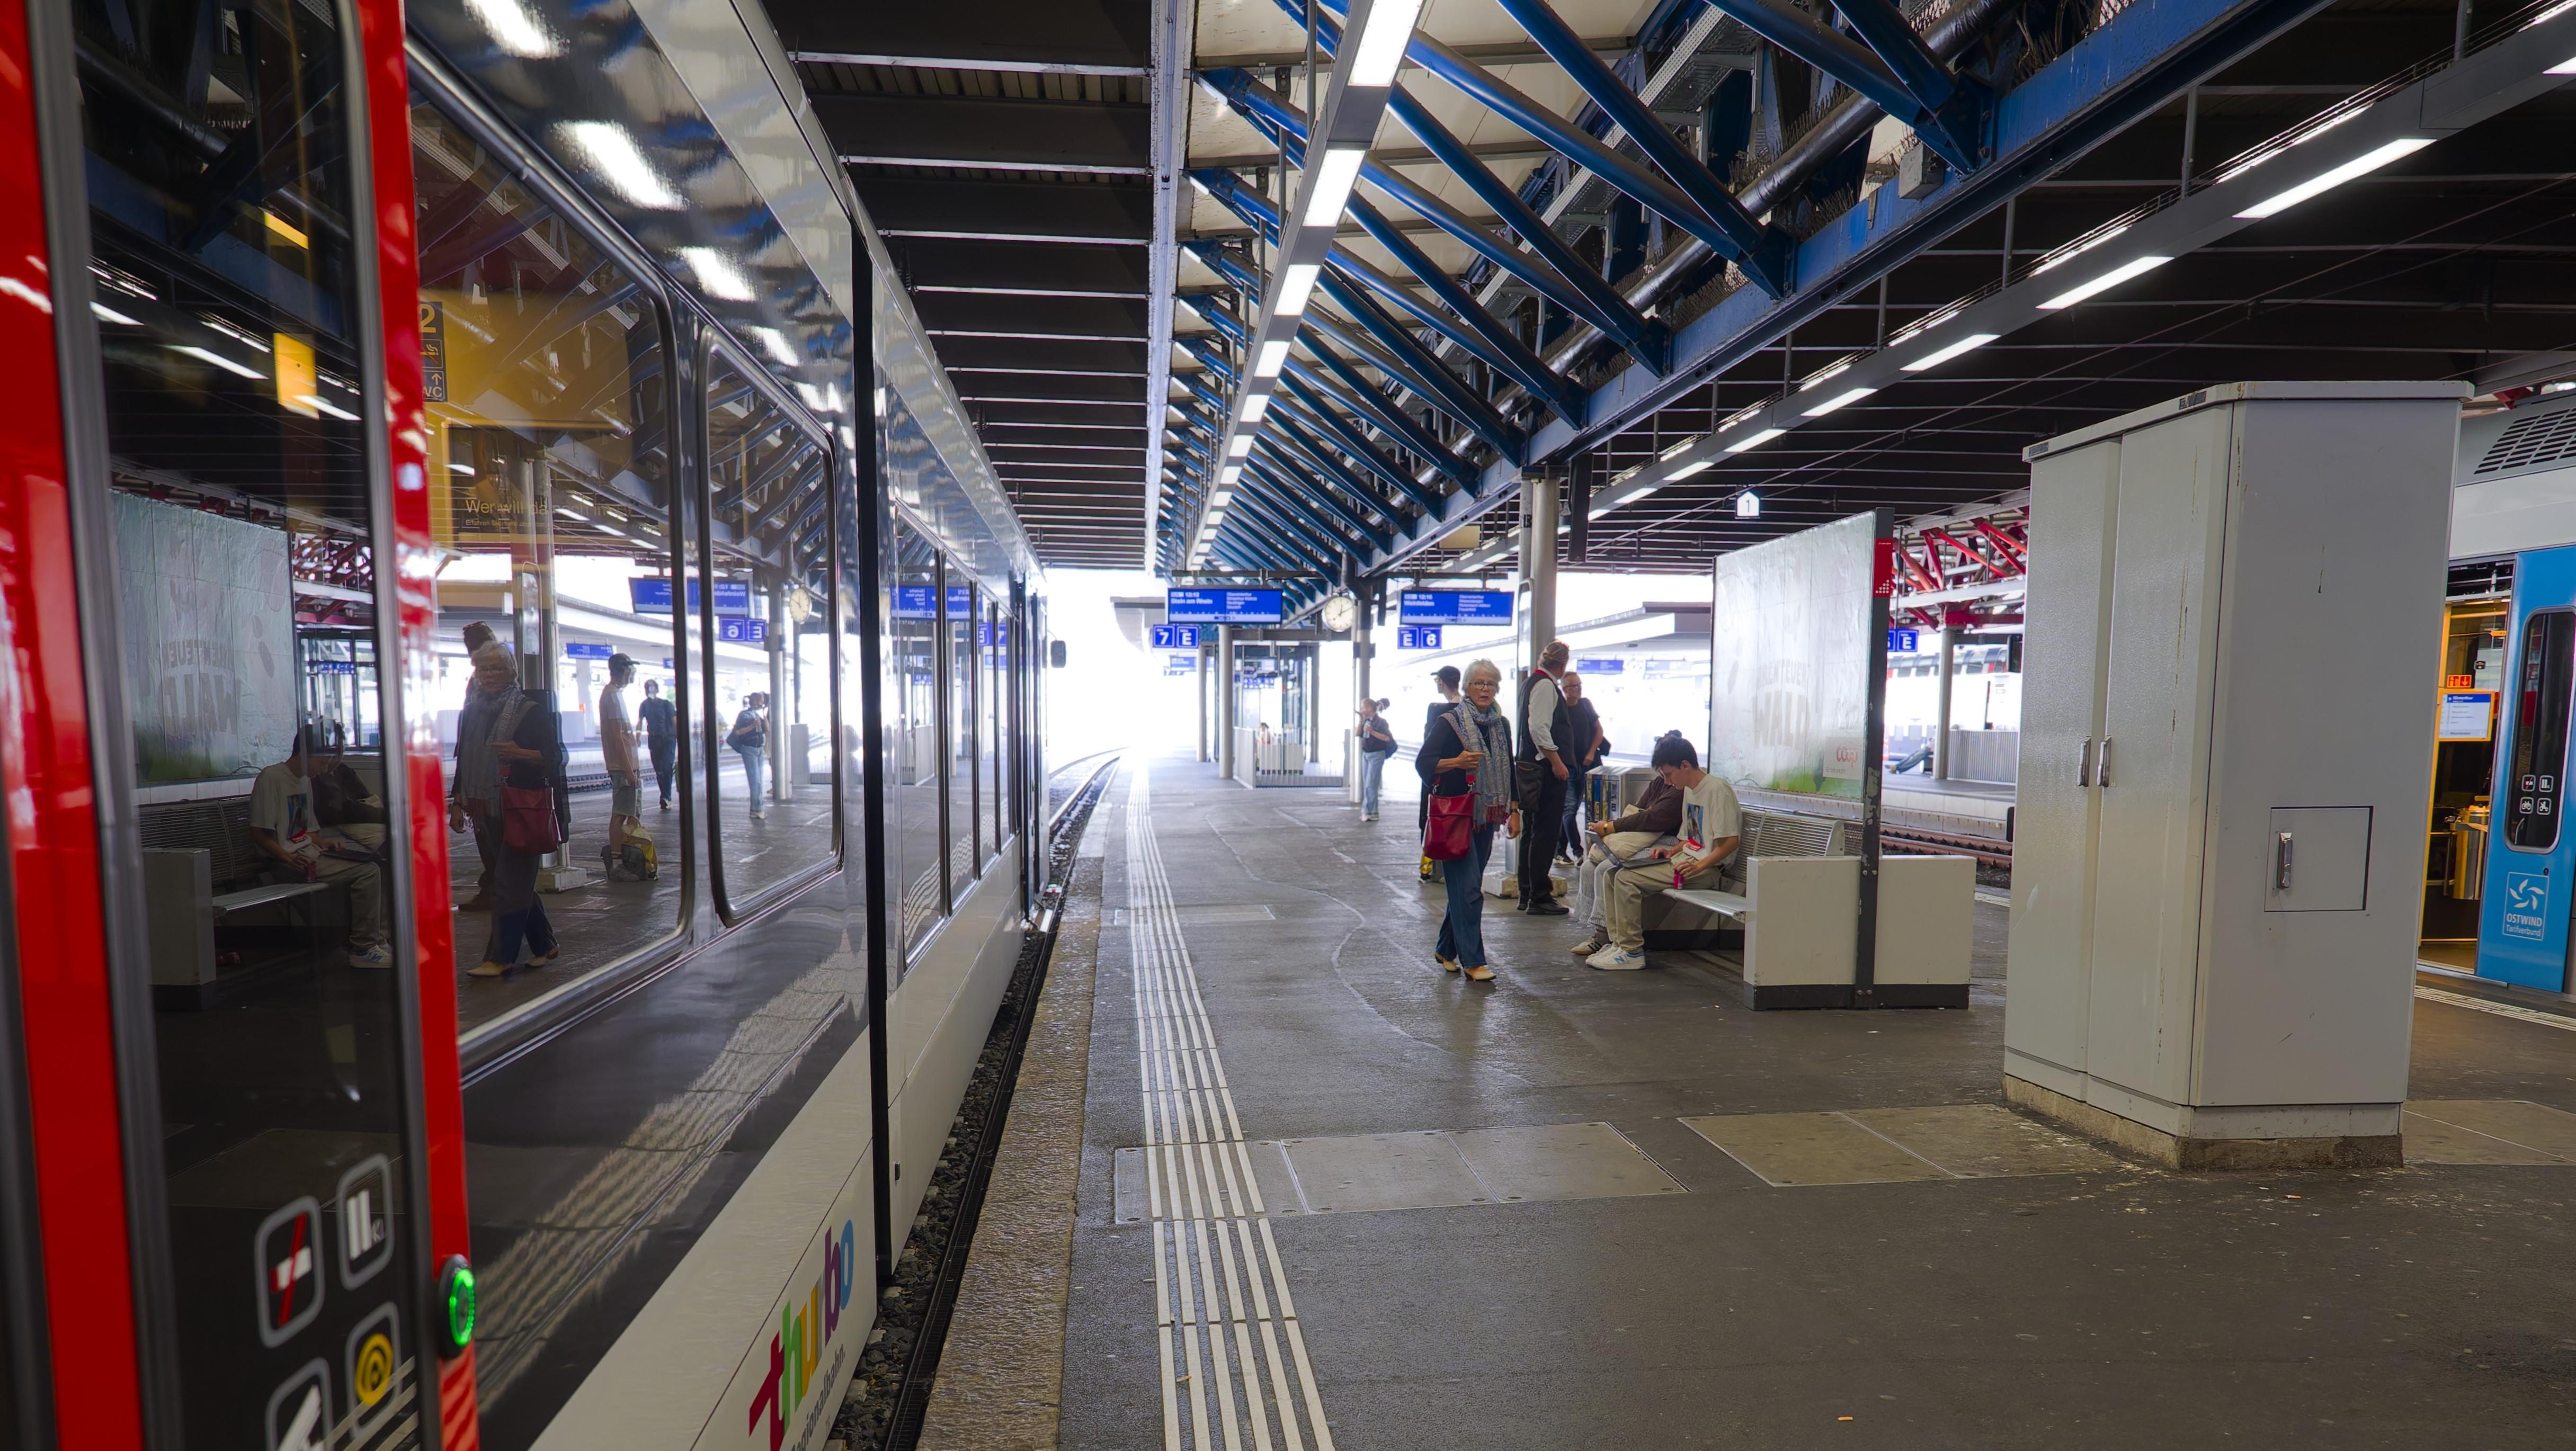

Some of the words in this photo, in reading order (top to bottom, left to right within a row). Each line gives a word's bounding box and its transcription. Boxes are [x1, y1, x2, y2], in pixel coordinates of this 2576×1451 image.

[418, 303, 436, 333] 2
[465, 499, 496, 514] Wer
[1746, 499, 1750, 513] 1
[1159, 632, 1169, 644] 7
[1182, 632, 1192, 646] E
[1403, 633, 1413, 646] E
[1426, 633, 1437, 646] 6
[1902, 637, 1912, 649] E
[1752, 690, 1810, 749] WALD
[2506, 912, 2542, 927] OSTWIND
[2506, 924, 2541, 937] Tarifverbund
[748, 1219, 854, 1451] thurbo
